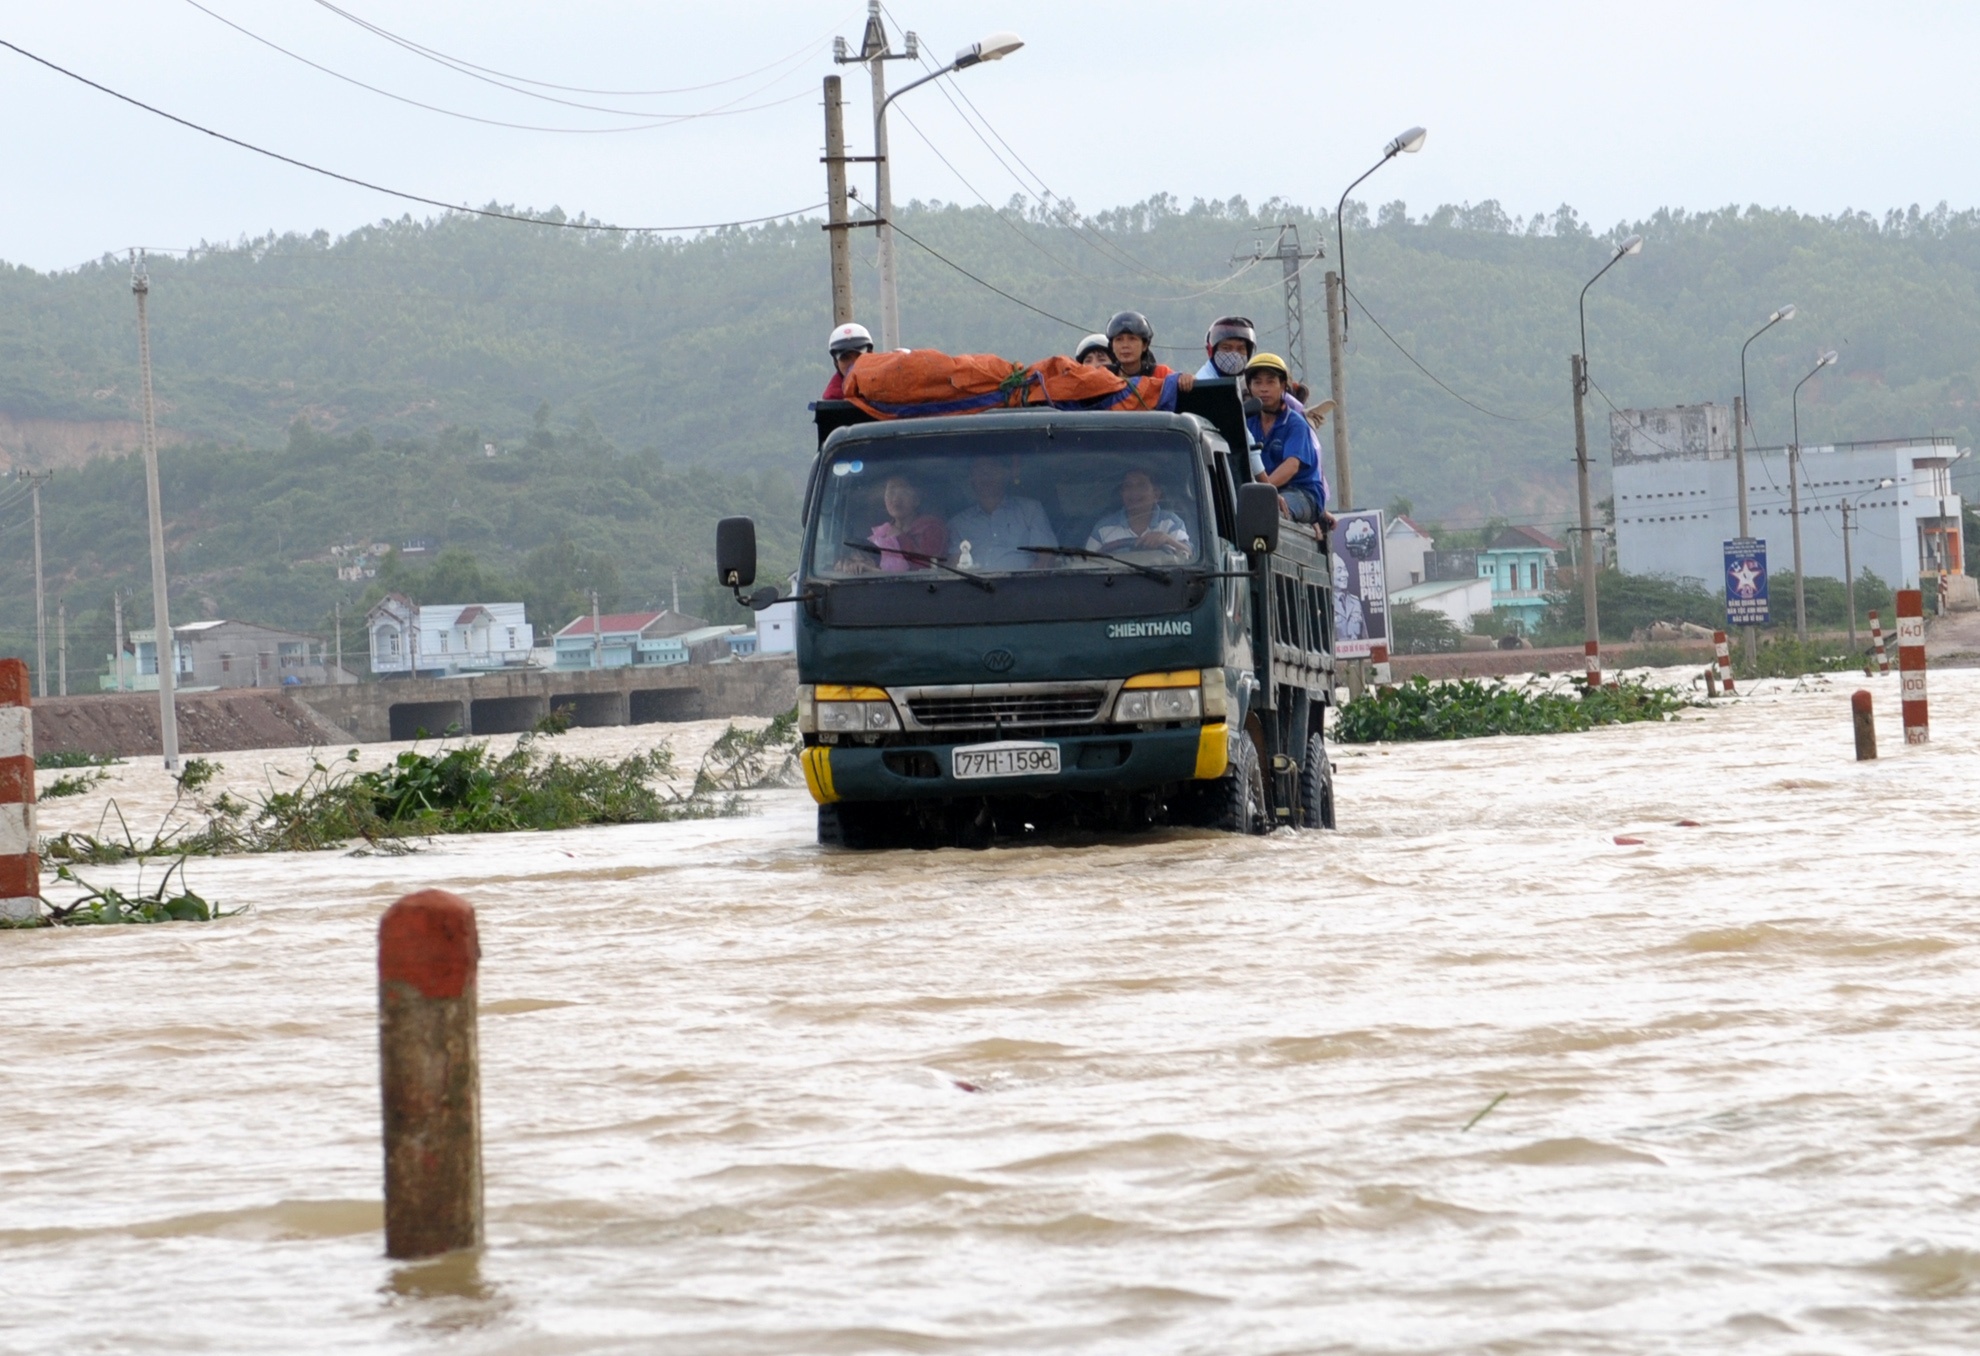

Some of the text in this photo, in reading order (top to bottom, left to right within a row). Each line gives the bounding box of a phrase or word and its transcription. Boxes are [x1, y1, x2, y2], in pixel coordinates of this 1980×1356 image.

[1900, 624, 1921, 637] 140
[1903, 678, 1924, 691] 100
[962, 750, 1052, 774] 77H-1598
